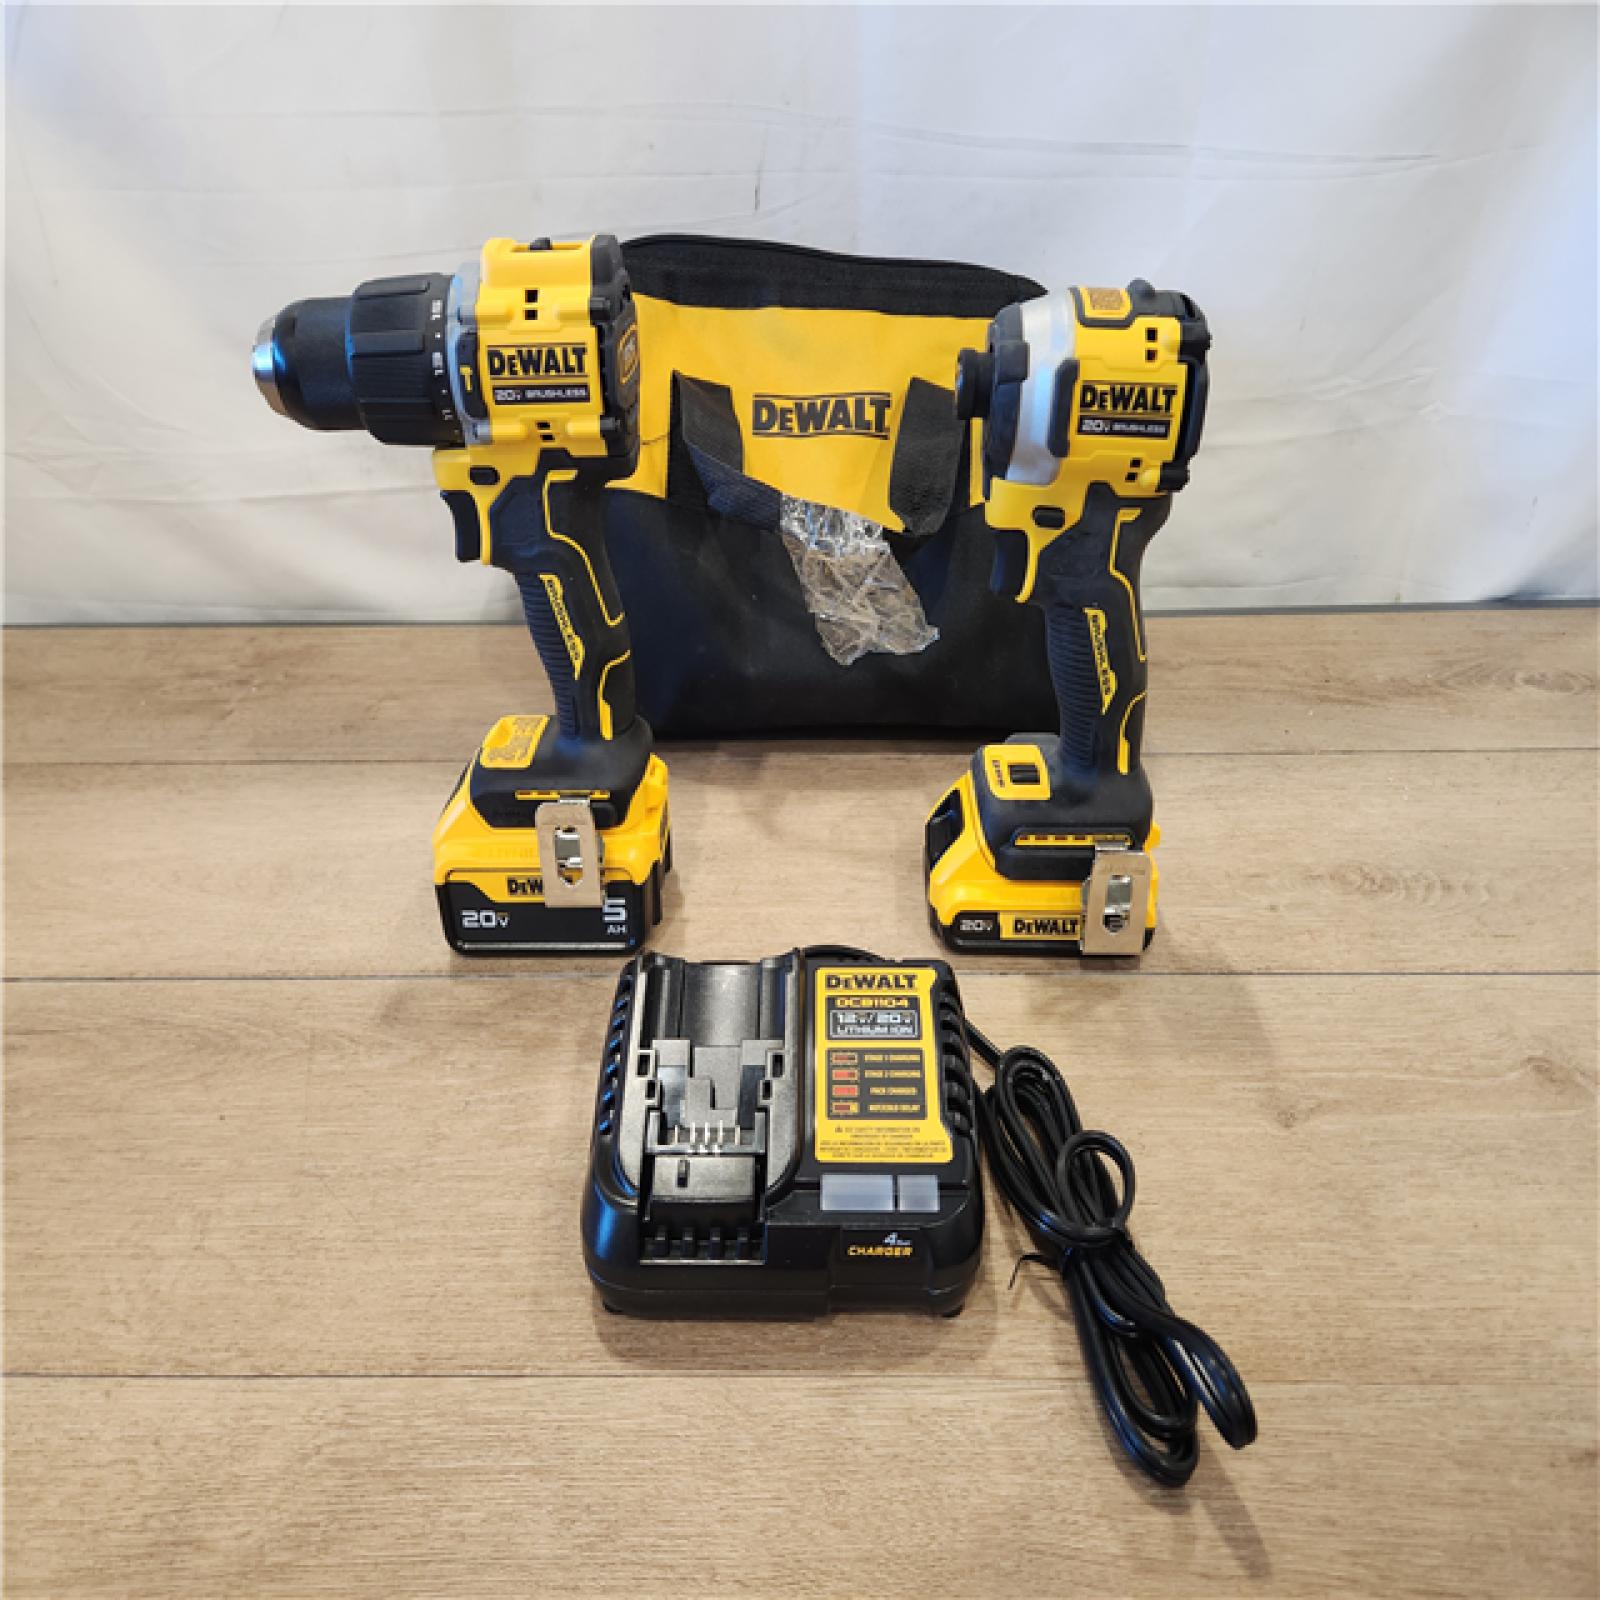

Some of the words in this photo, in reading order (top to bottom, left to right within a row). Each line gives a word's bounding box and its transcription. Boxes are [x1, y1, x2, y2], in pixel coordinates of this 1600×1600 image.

[507, 878, 543, 894] DEW
[603, 898, 627, 921] 5
[847, 1245, 914, 1258] CHARGER
